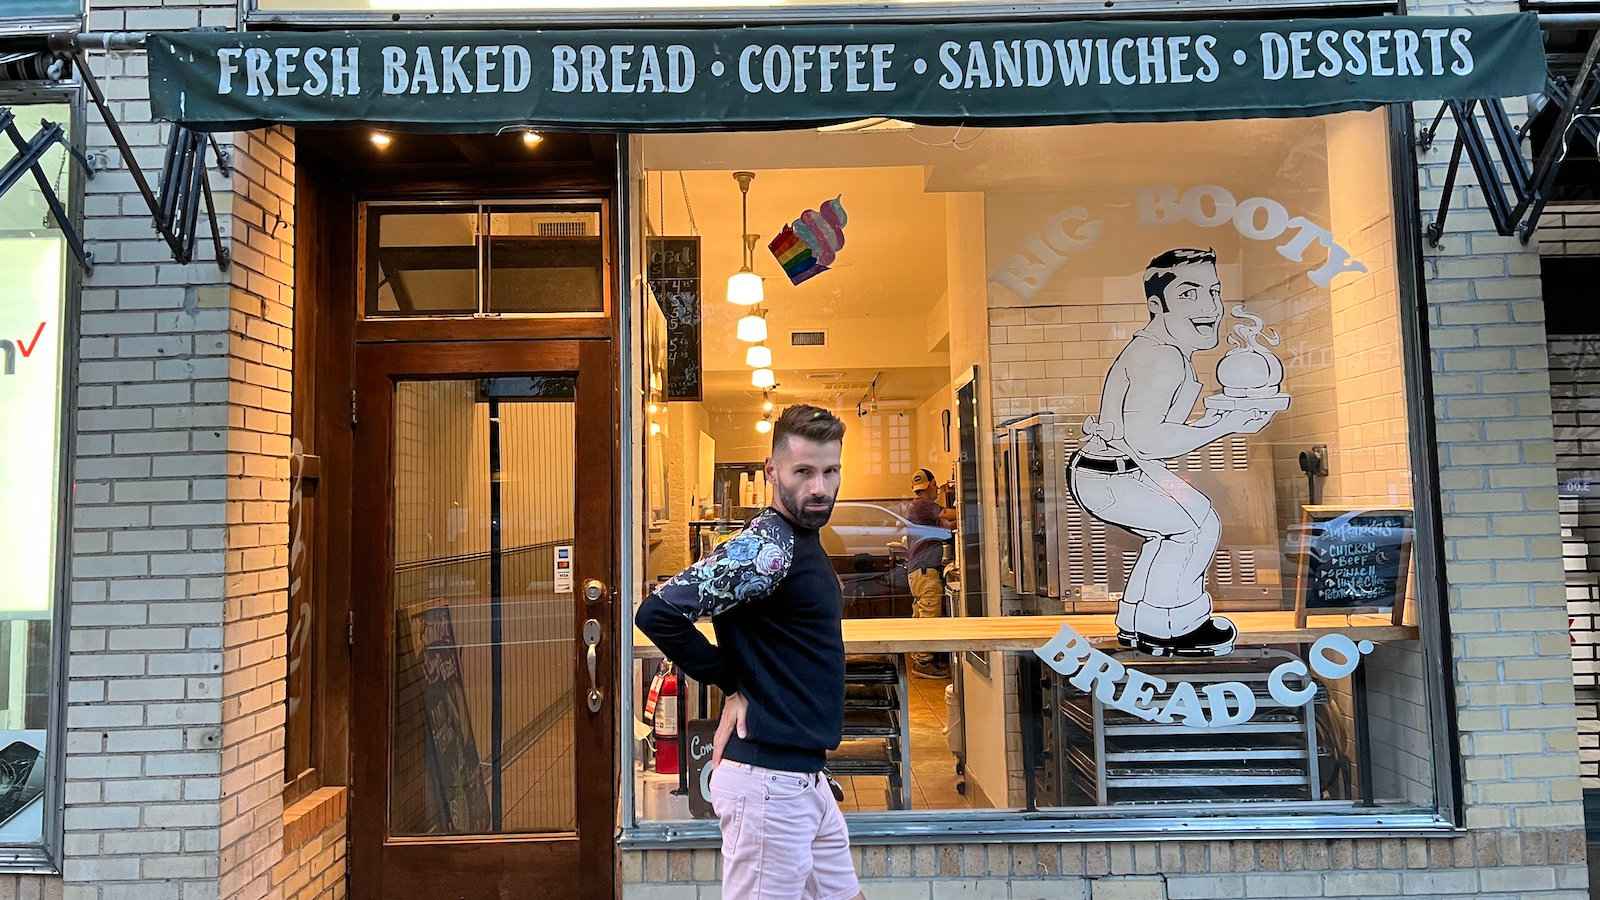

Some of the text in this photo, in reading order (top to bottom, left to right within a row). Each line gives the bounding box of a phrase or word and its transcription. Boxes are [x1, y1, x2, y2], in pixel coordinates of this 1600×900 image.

[217, 27, 1474, 96] FRESH BAKED BREAD COFFEE SANDWICHES DESSERTS
[991, 185, 1368, 299] BIG BOOTY
[1033, 624, 1374, 728] BREAD CO.
